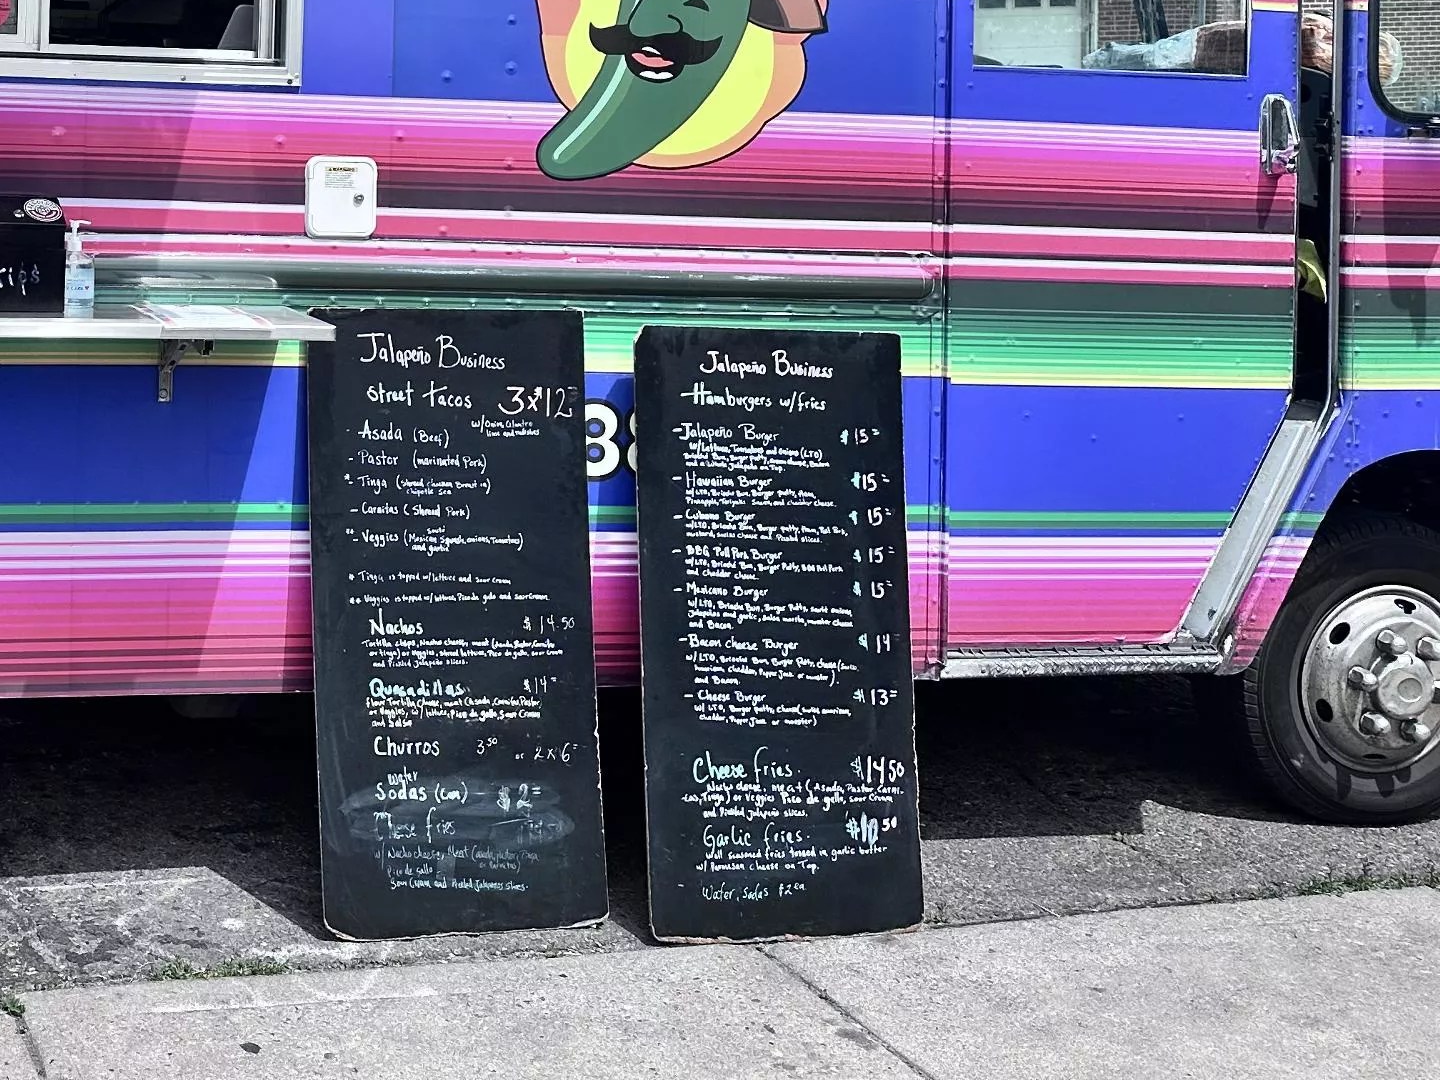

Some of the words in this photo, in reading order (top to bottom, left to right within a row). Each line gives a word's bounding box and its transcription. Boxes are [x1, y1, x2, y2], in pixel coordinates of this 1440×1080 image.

[357, 332, 431, 368] Jalapeño
[436, 334, 505, 369] Business
[700, 350, 766, 379] Jalapeño
[772, 349, 833, 378] Business
[358, 419, 403, 440] Asada
[413, 426, 450, 449] (Beef)
[738, 423, 779, 446] Burger
[358, 449, 398, 466] Pastor
[412, 449, 460, 469] (marinated
[800, 447, 823, 461] (LTO)
[357, 474, 388, 495] Tinga
[686, 471, 734, 488] Hawaiian
[737, 475, 772, 491] Burger
[361, 501, 399, 515] Carnitas
[724, 511, 756, 524] Burger
[362, 528, 399, 548] Veggies
[750, 549, 782, 564] Burger
[732, 585, 769, 602] Burger
[368, 607, 424, 636] Nachos
[687, 633, 722, 648] Bacon
[761, 638, 799, 657] Burger
[696, 689, 731, 702] Cheese
[734, 690, 767, 706] Burger
[373, 735, 440, 757] Churros
[692, 750, 748, 783] Cheese
[375, 781, 428, 802] Sodas
[703, 824, 752, 854] Garlic
[819, 849, 829, 857] in
[831, 846, 856, 862] garlic
[858, 844, 888, 855] butter
[434, 876, 448, 888] and
